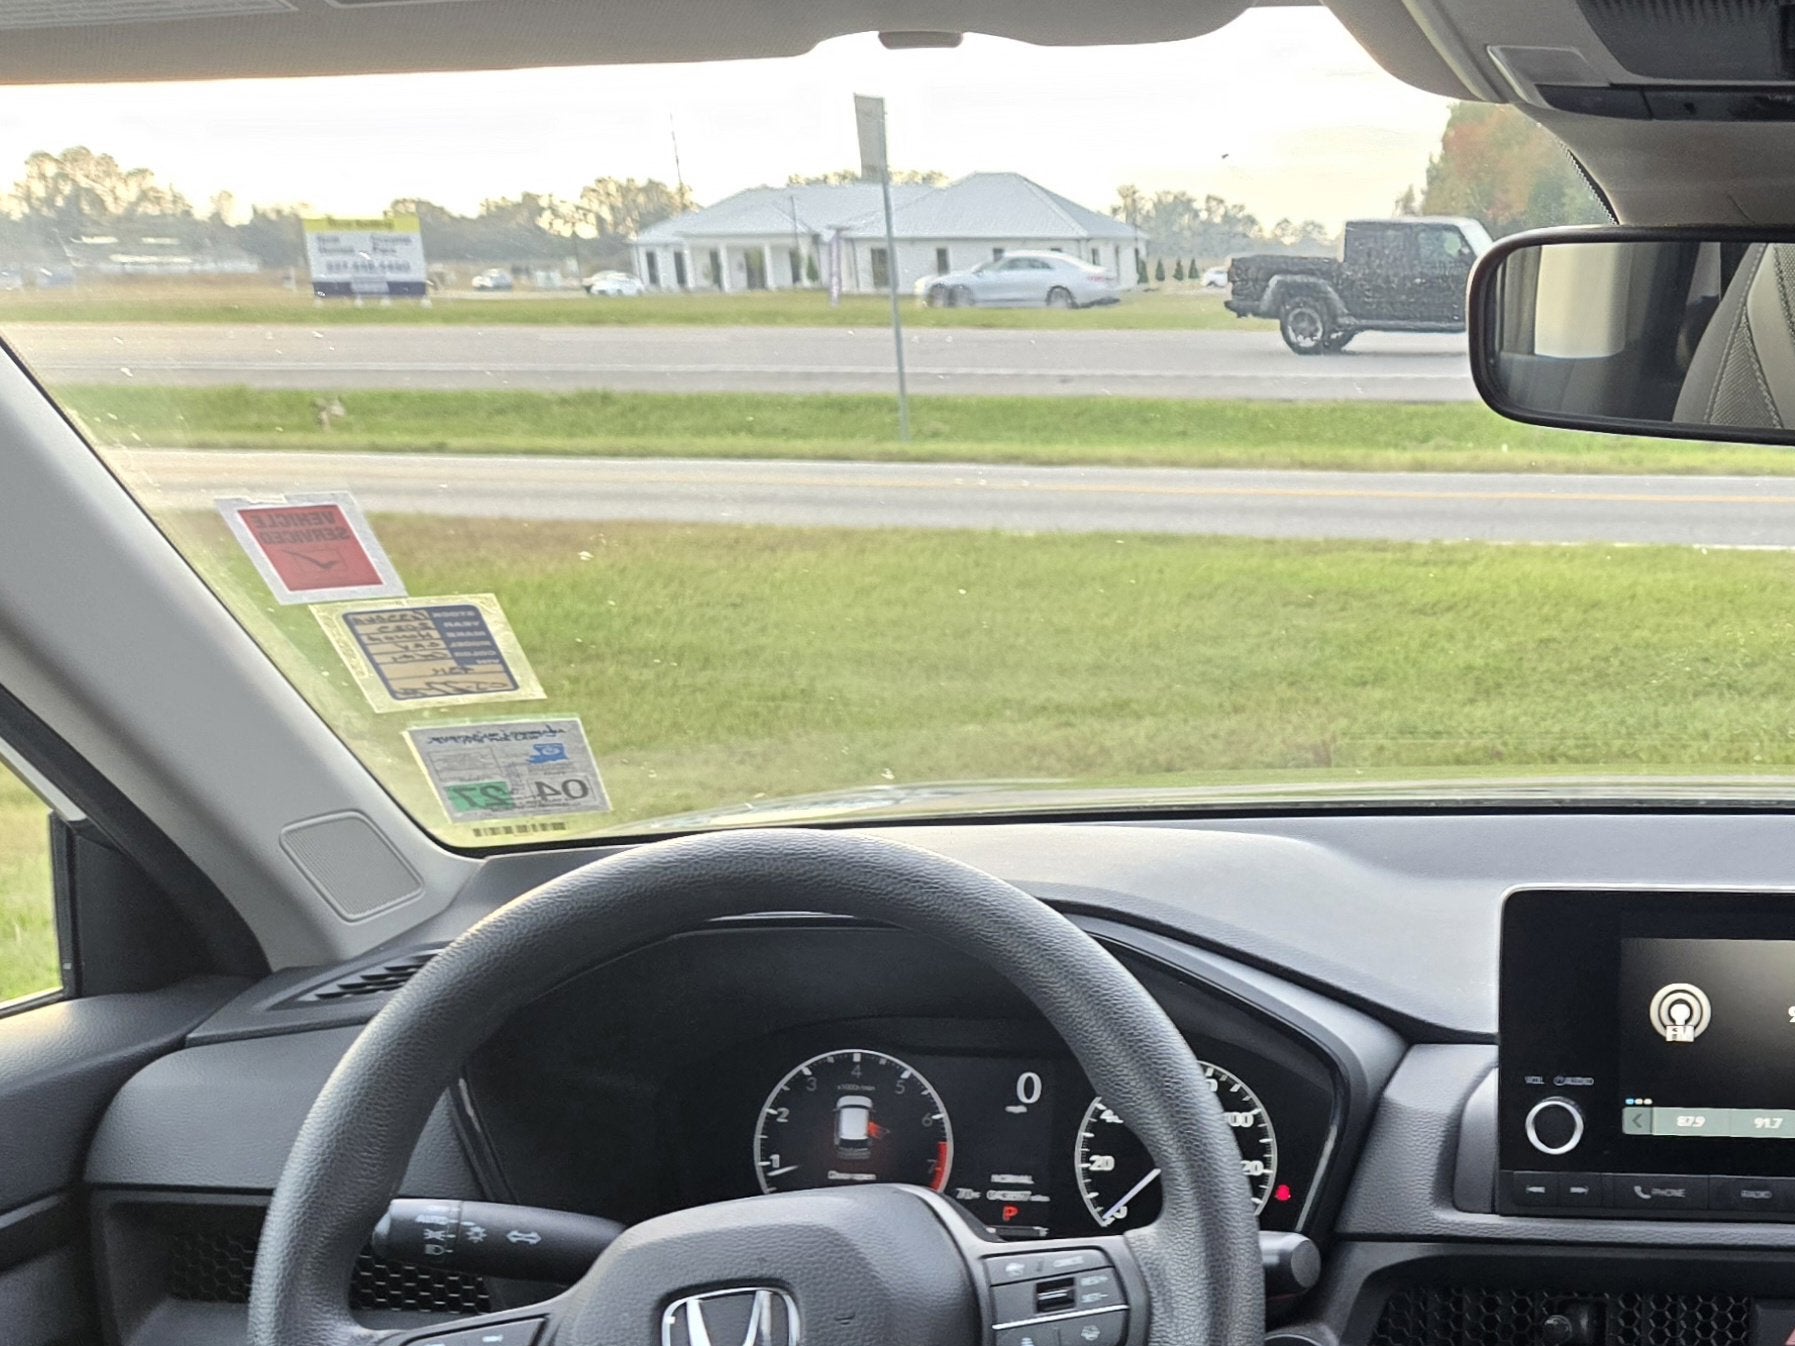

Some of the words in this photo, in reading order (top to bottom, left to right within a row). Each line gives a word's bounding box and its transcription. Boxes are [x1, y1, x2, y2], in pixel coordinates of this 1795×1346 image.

[850, 1064, 863, 1079] 4
[805, 1078, 818, 1092] 3
[895, 1080, 906, 1095] 5
[1016, 1071, 1043, 1105] 0
[776, 1107, 791, 1123] 2
[921, 1116, 933, 1127] 6
[1224, 1111, 1255, 1128] 00
[1754, 1116, 1784, 1130] 91.7
[769, 1154, 781, 1169] 1
[1088, 1155, 1116, 1172] 20
[1002, 1204, 1020, 1222] P
